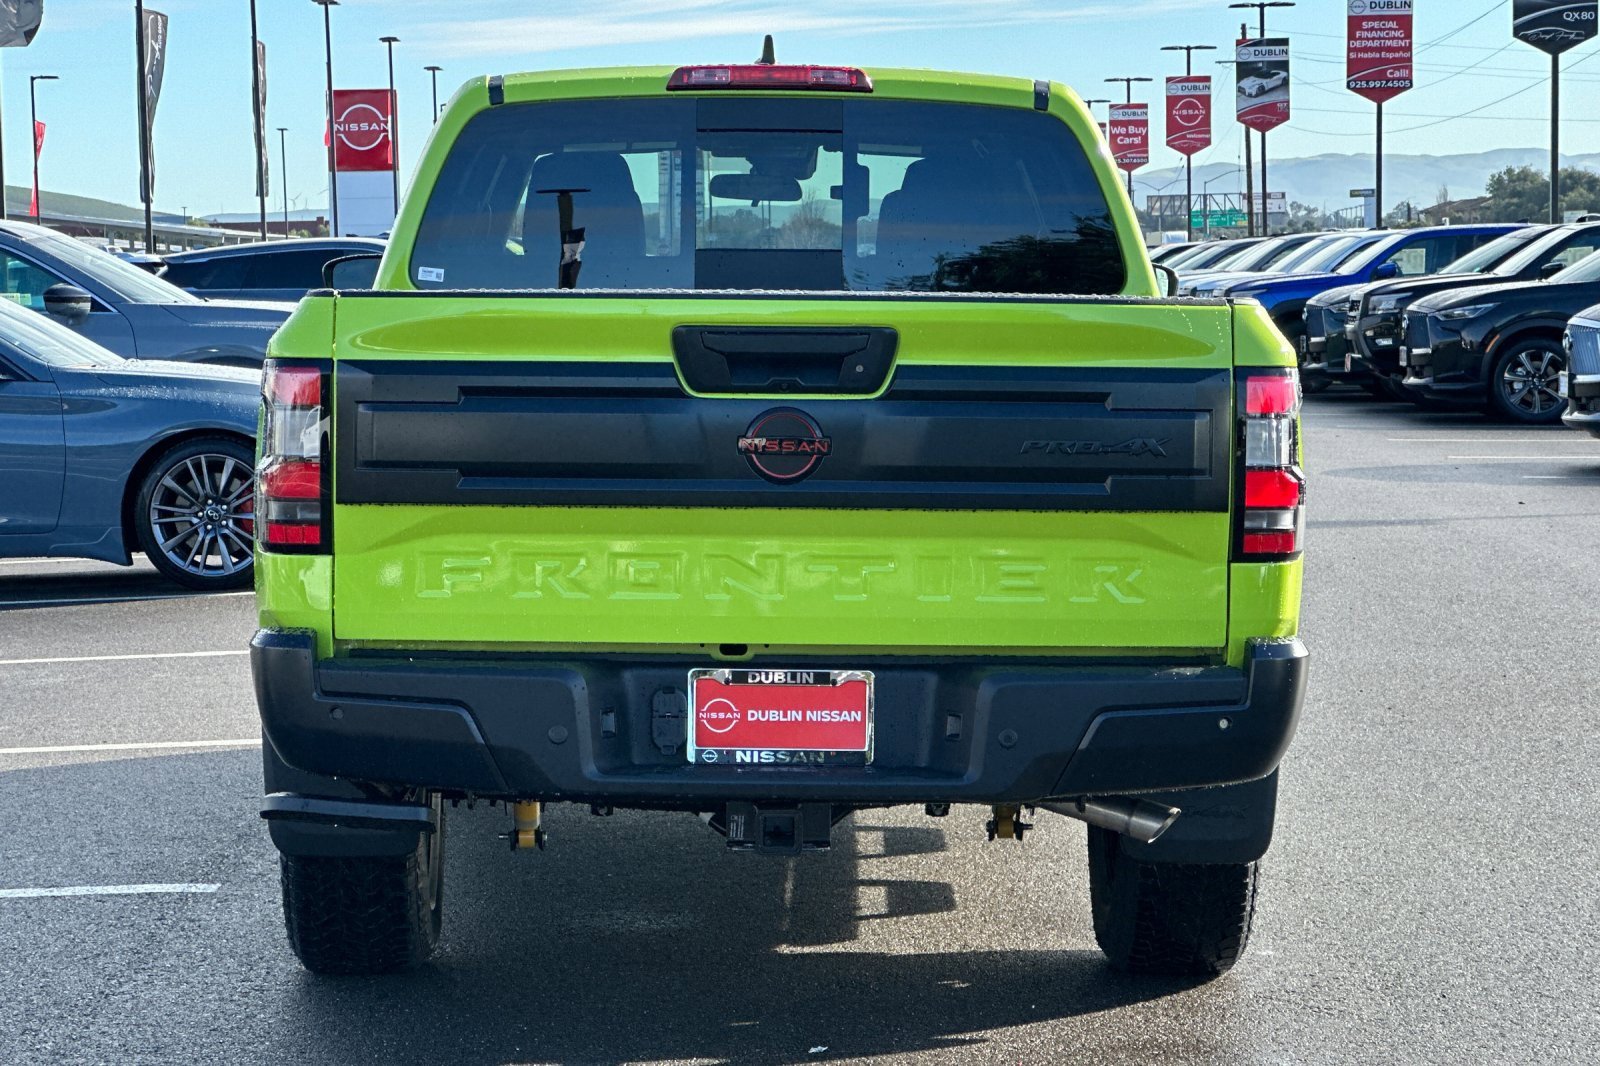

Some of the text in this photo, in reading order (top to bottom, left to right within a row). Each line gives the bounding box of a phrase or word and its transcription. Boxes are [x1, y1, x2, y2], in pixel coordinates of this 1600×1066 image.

[1370, 1, 1411, 9] DUBLIN
[1362, 21, 1399, 29] SPECIAL
[1355, 30, 1405, 38] FINANCING
[1349, 40, 1411, 48] DEPARTMENT
[1253, 48, 1288, 57] DUBLIN
[1381, 51, 1411, 59] Español
[1386, 69, 1409, 78] Call!
[1180, 84, 1211, 92] DUBLIN
[1349, 80, 1411, 88] 925.997.4505
[1172, 108, 1206, 116] NISSAN
[335, 122, 388, 131] NISSAN
[1110, 126, 1127, 134] We
[1128, 126, 1147, 136] Buy
[1117, 136, 1142, 144] Cars!
[739, 439, 829, 453] NISSAN
[415, 550, 1146, 603] FRONTIER
[747, 671, 814, 684] DUBLIN
[747, 710, 862, 722] DUBLIN NISSAN
[736, 750, 825, 763] NISSAN
